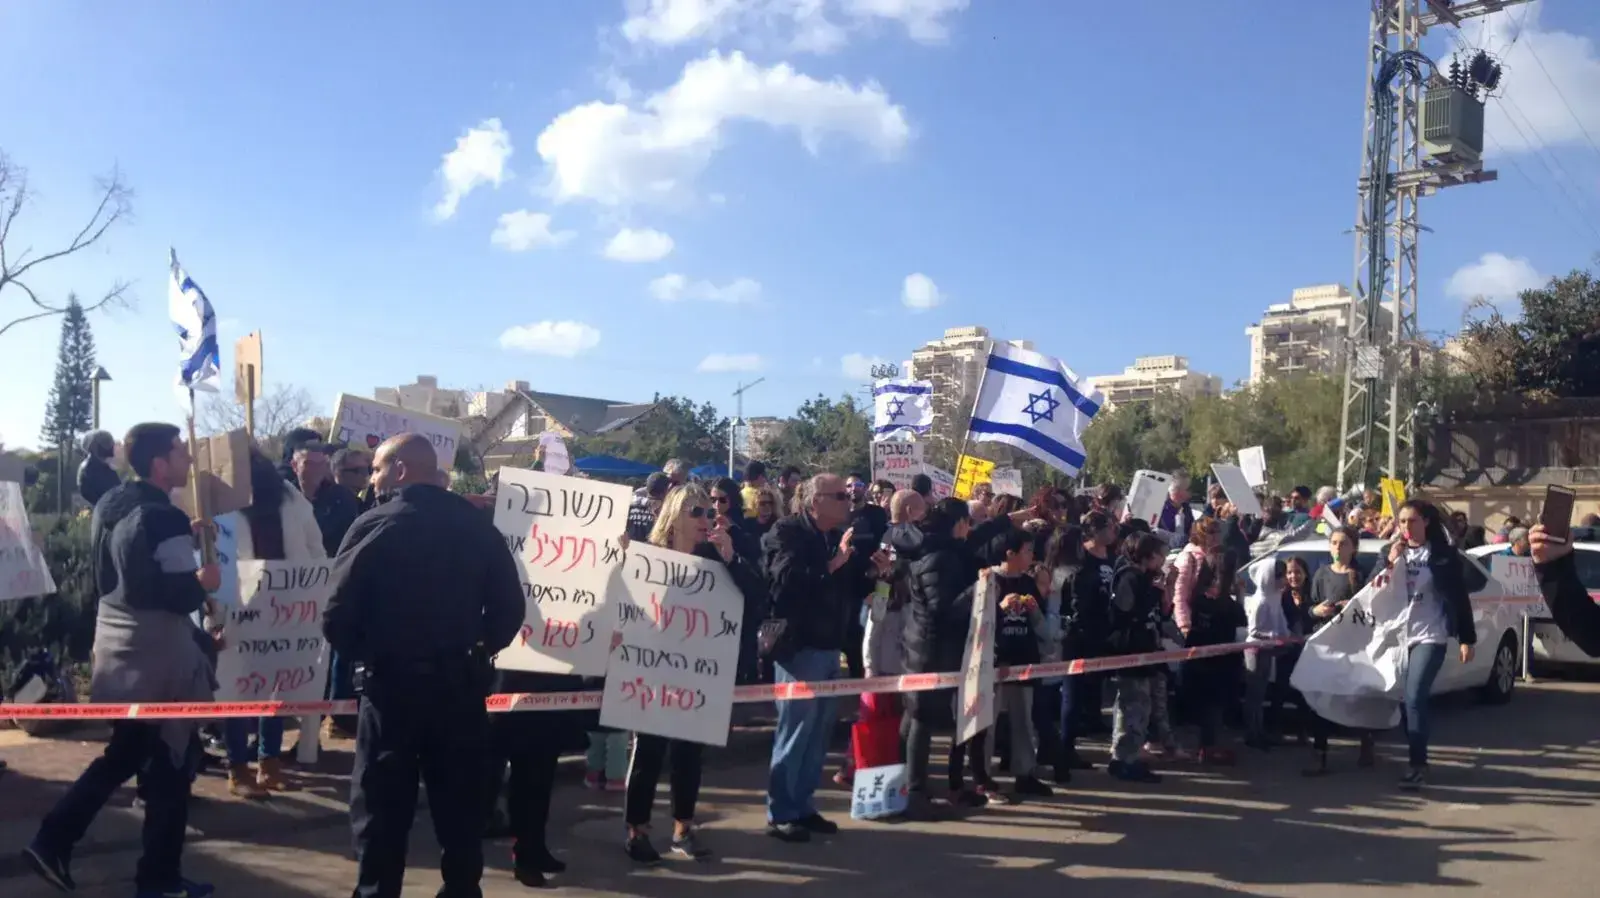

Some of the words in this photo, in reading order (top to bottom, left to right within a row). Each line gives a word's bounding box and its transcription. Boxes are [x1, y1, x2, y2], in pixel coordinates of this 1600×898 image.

[878, 443, 913, 455] תשובה
[507, 482, 613, 527] תשובה
[530, 524, 596, 572] תרעיל
[257, 566, 329, 592] תשובה
[635, 553, 715, 595] תשובה
[649, 592, 709, 639] תרעיל
[714, 611, 738, 638] אל
